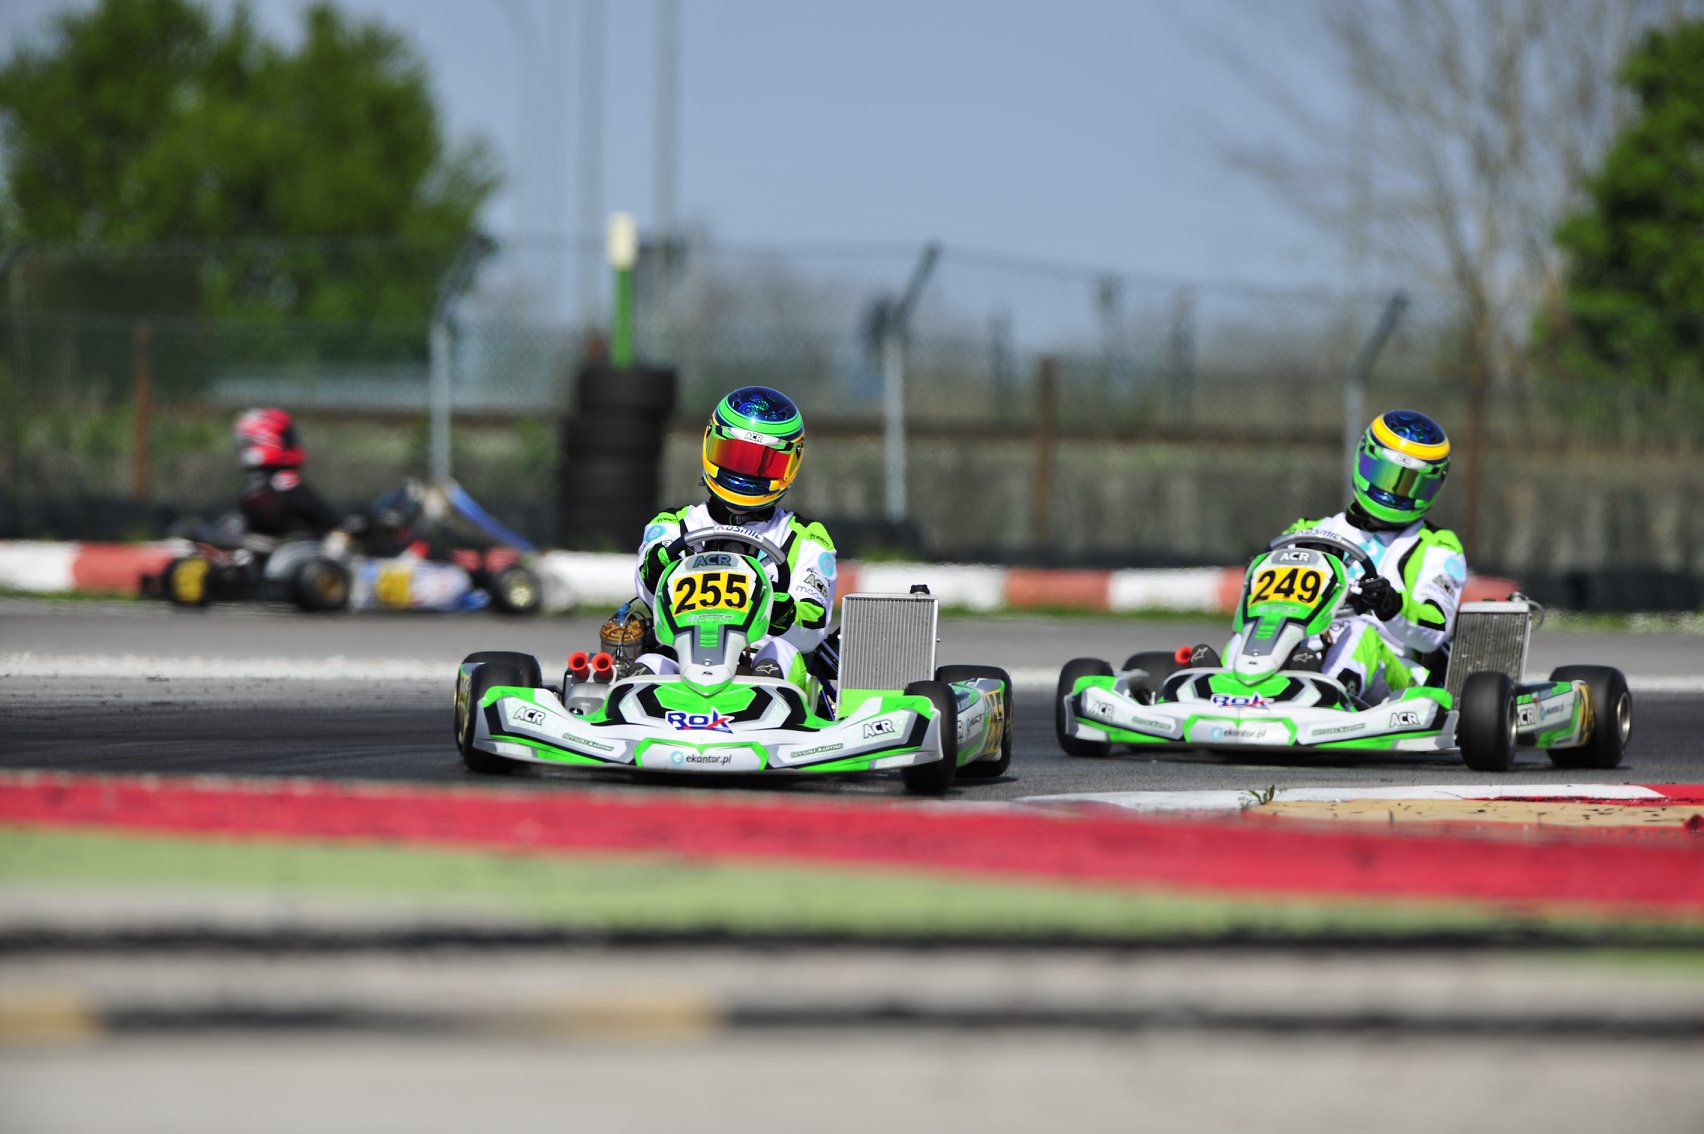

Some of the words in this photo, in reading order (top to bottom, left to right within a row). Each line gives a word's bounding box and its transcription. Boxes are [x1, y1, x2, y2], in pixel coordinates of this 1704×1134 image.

[744, 431, 763, 443] ACR
[692, 553, 732, 569] ACR
[1279, 551, 1310, 562] ACR
[674, 572, 747, 615] 255
[803, 573, 828, 598] ACR
[1251, 567, 1321, 604] 249
[513, 705, 546, 726] ACR
[1089, 701, 1115, 719] ACR
[1389, 711, 1421, 728] ACR
[1517, 706, 1536, 727] CR
[863, 719, 895, 739] ACR
[685, 753, 732, 766] ekantor.pl
